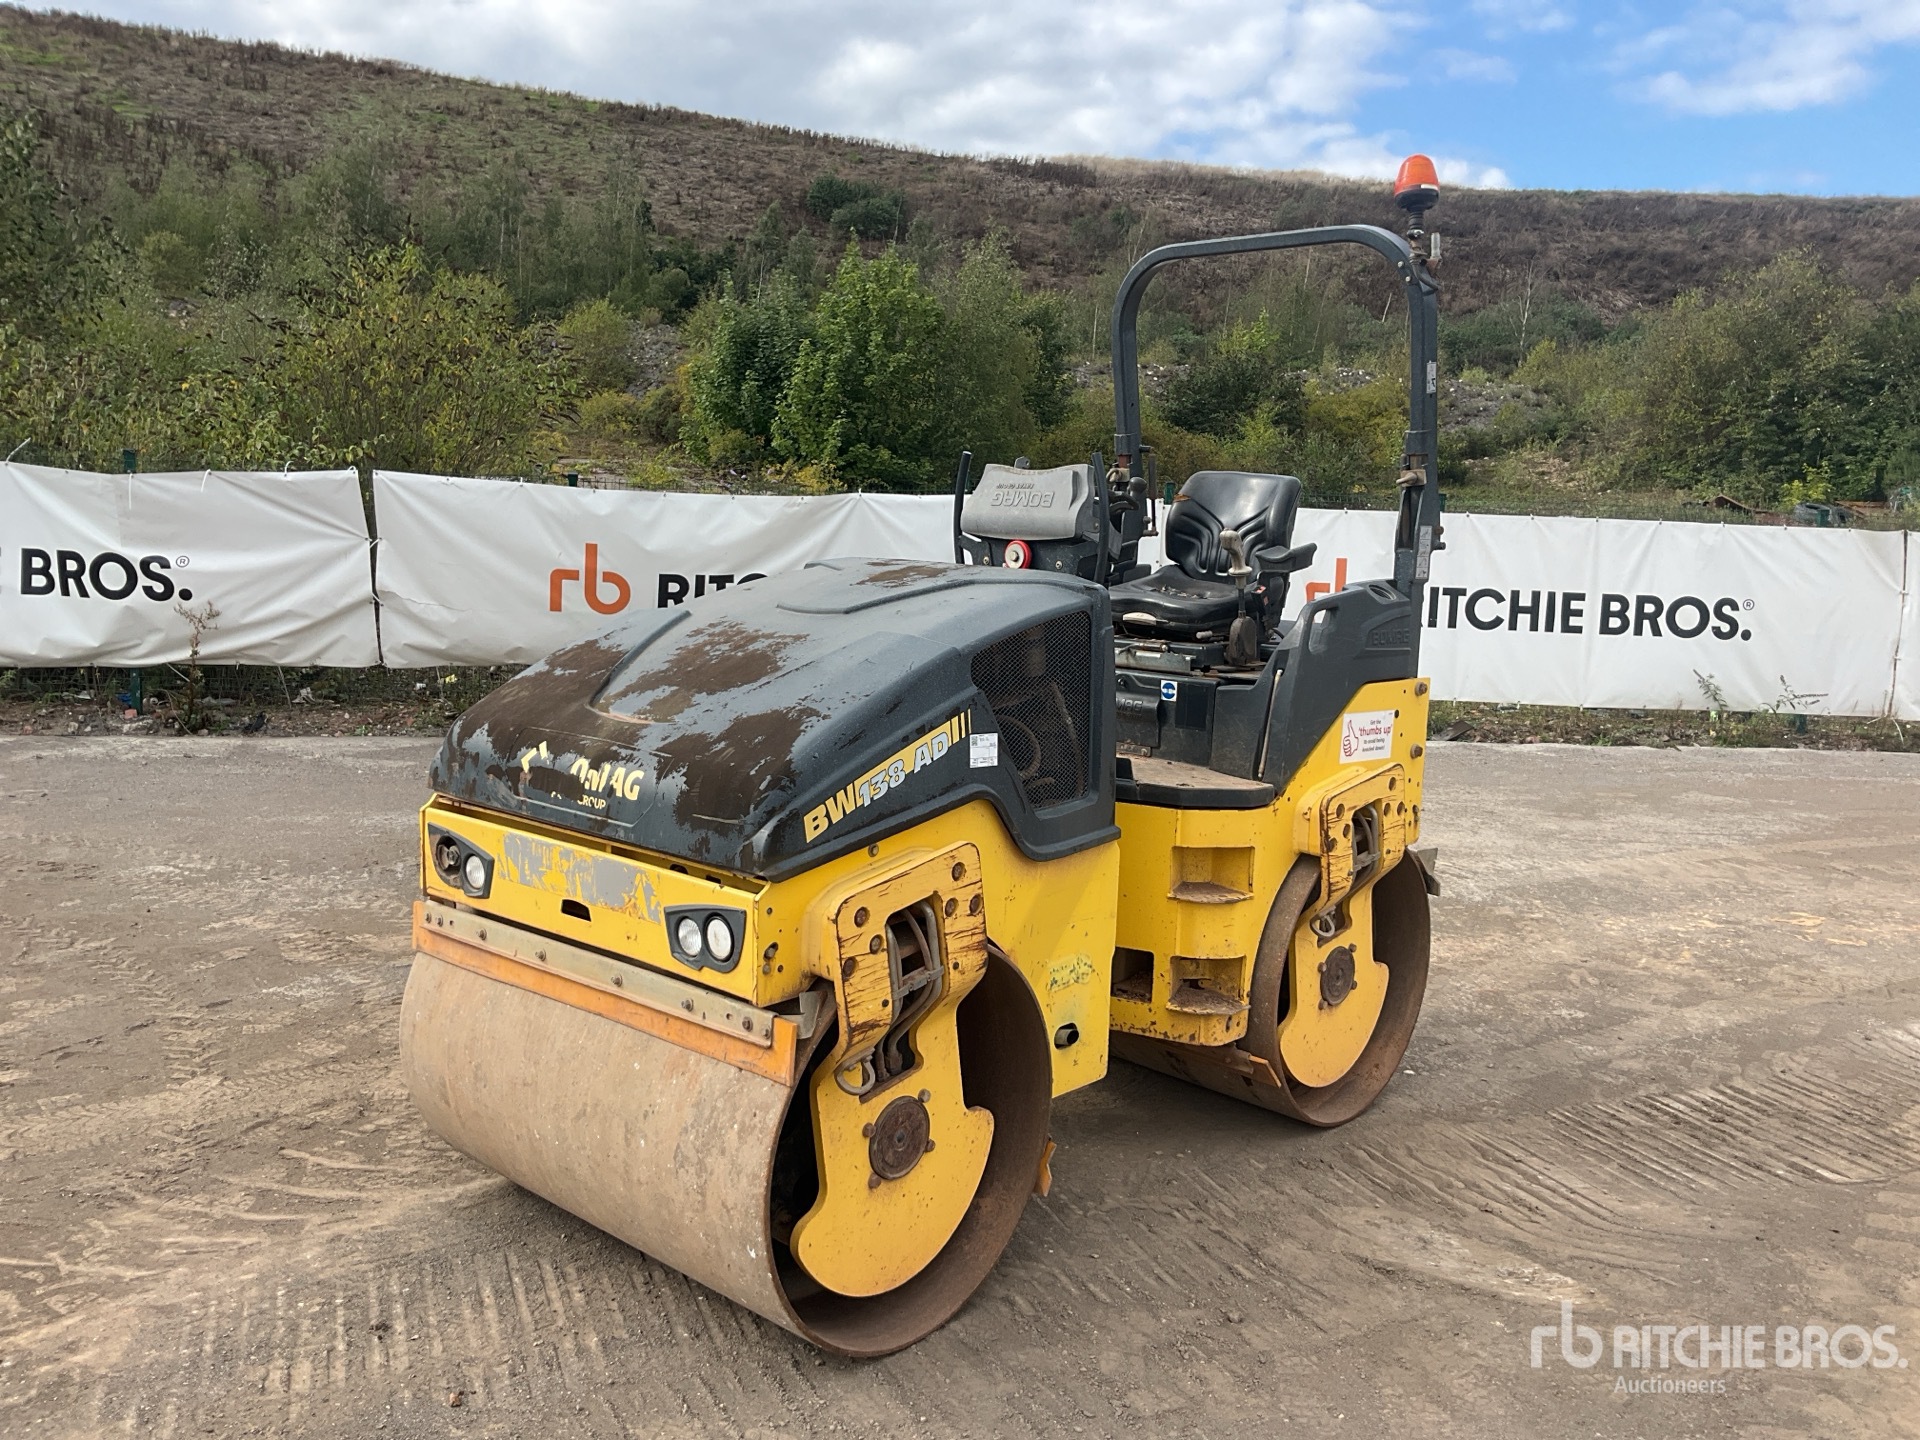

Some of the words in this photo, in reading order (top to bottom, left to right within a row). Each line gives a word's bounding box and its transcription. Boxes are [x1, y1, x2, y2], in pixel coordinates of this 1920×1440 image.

[990, 490, 1055, 508] BOMAG
[549, 542, 632, 615] rb
[1421, 586, 1587, 634] ITCHIE
[913, 731, 950, 774] AD
